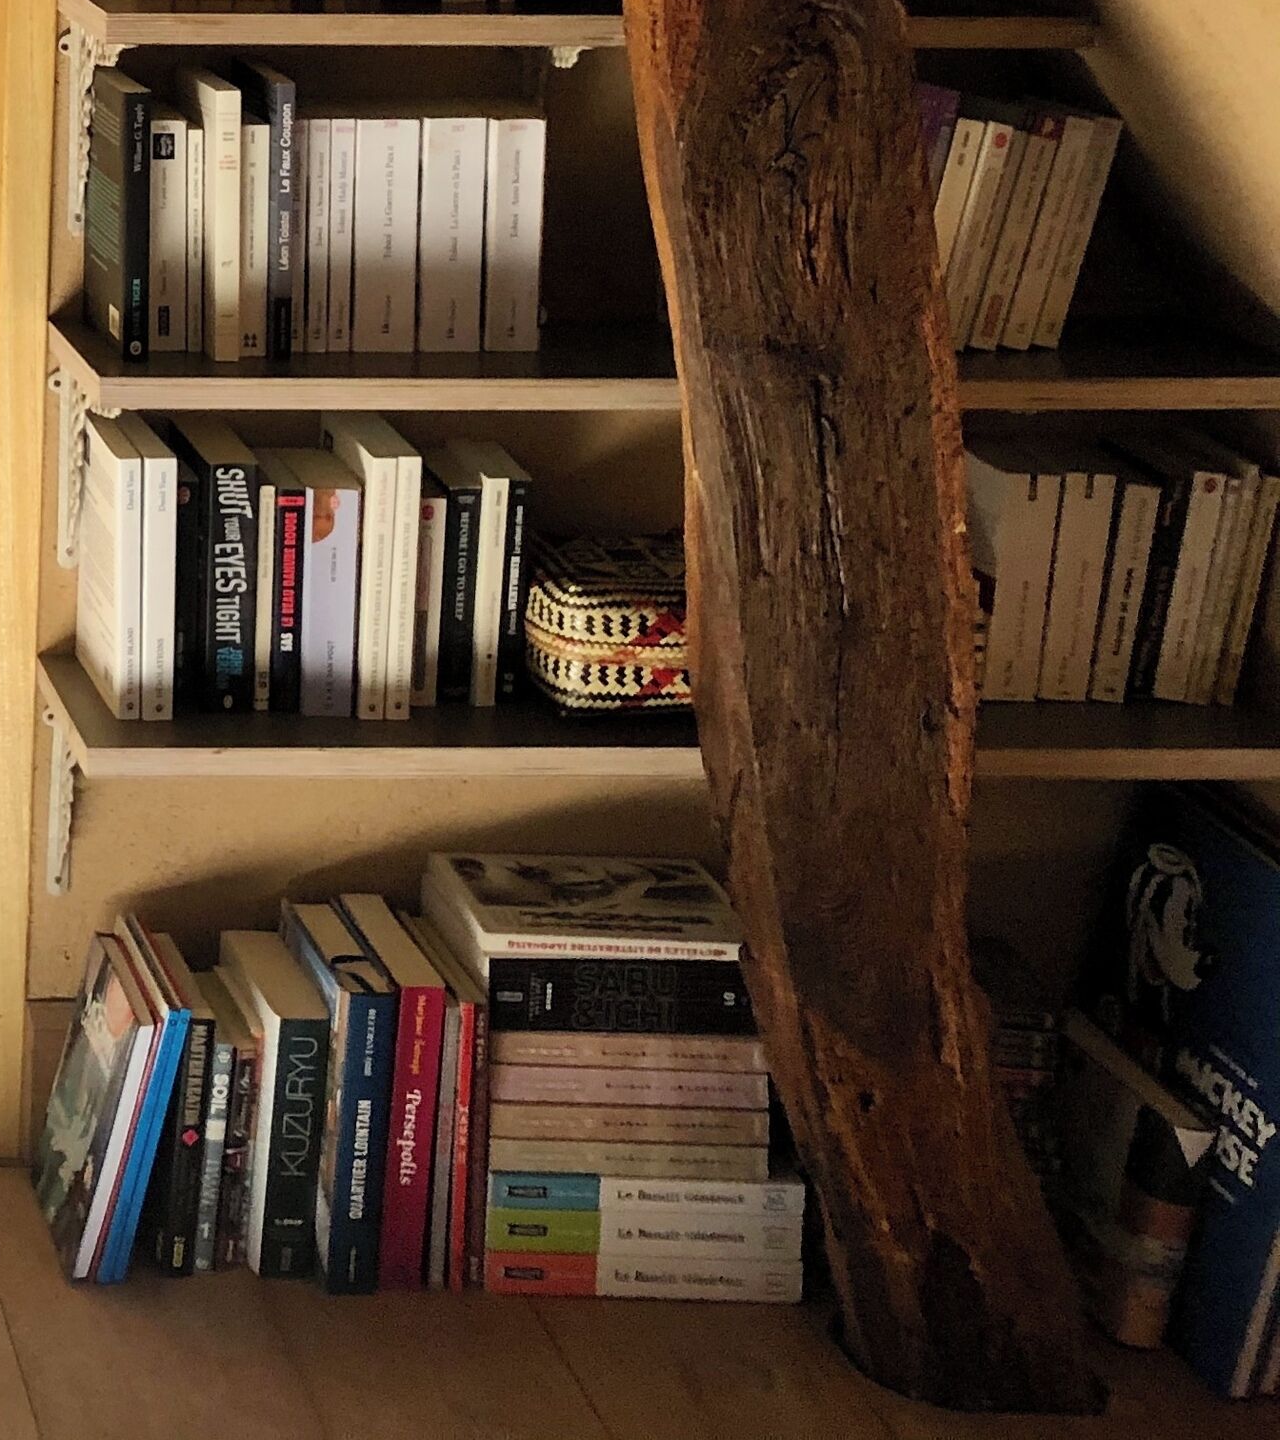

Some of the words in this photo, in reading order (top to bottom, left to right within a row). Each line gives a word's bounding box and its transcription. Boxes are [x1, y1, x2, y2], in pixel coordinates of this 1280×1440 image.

[133, 103, 145, 130] Tapply
[281, 103, 294, 148] Coupon
[133, 141, 143, 173] William
[279, 149, 291, 177] Faux
[279, 177, 290, 193] Le
[384, 189, 394, 216] Guerre
[450, 190, 460, 218] Guerre
[278, 210, 290, 244] Tolstoï
[278, 245, 289, 271] Léon
[131, 278, 141, 307] TIGER
[125, 490, 135, 511] David
[157, 491, 167, 512] David
[215, 467, 253, 519] SHUT
[223, 517, 240, 541] YOUR
[284, 511, 298, 546] ROUGE
[458, 511, 471, 550] BEFORE
[214, 543, 248, 593] EYES
[283, 547, 296, 587] DANUBE
[458, 557, 468, 573] GO
[456, 575, 467, 589] TO
[281, 589, 295, 614] BEAU
[454, 591, 466, 621] SLEEP
[215, 596, 241, 644] TIGHT
[281, 616, 294, 628] LE
[126, 627, 135, 656] ISLAND
[280, 632, 293, 652] SAS
[230, 647, 243, 675] JOHN
[573, 963, 679, 996] SABU
[209, 1072, 231, 1113] SOIL
[279, 1035, 319, 1177] KUZURYU
[352, 1099, 373, 1157] LOINTAIN
[396, 1088, 424, 1187] Persepolis
[348, 1158, 368, 1220] QUARTIER
[617, 1189, 634, 1201] Le
[617, 1229, 634, 1241] Le
[615, 1271, 632, 1283] Le
